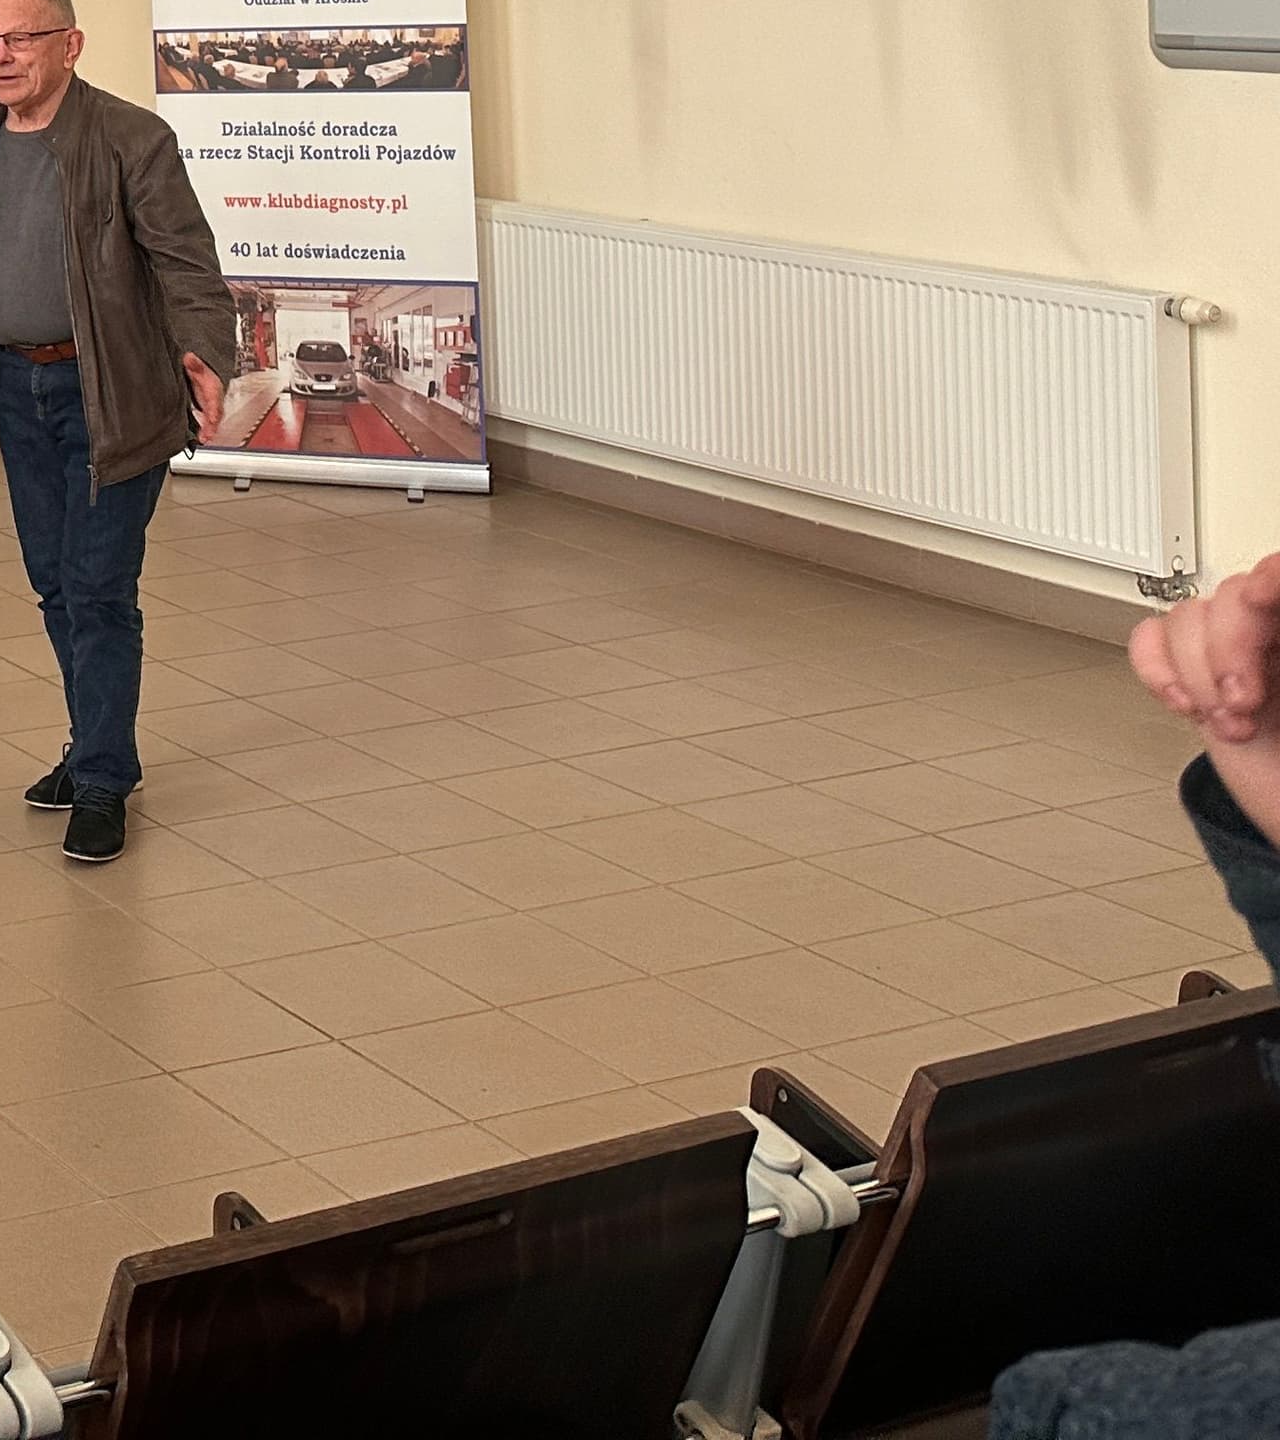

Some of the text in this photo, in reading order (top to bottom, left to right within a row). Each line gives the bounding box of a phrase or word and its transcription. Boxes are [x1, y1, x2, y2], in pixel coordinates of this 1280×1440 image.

[221, 121, 398, 137] Działalność doradcza
[200, 148, 242, 159] rzecz
[247, 145, 294, 164] Stacji
[300, 145, 370, 160] Kontroli
[376, 144, 456, 164] Pojazdów
[224, 193, 408, 214] www.klubdiagnosty.pl
[230, 242, 406, 261] 40 lat doświadczenia
